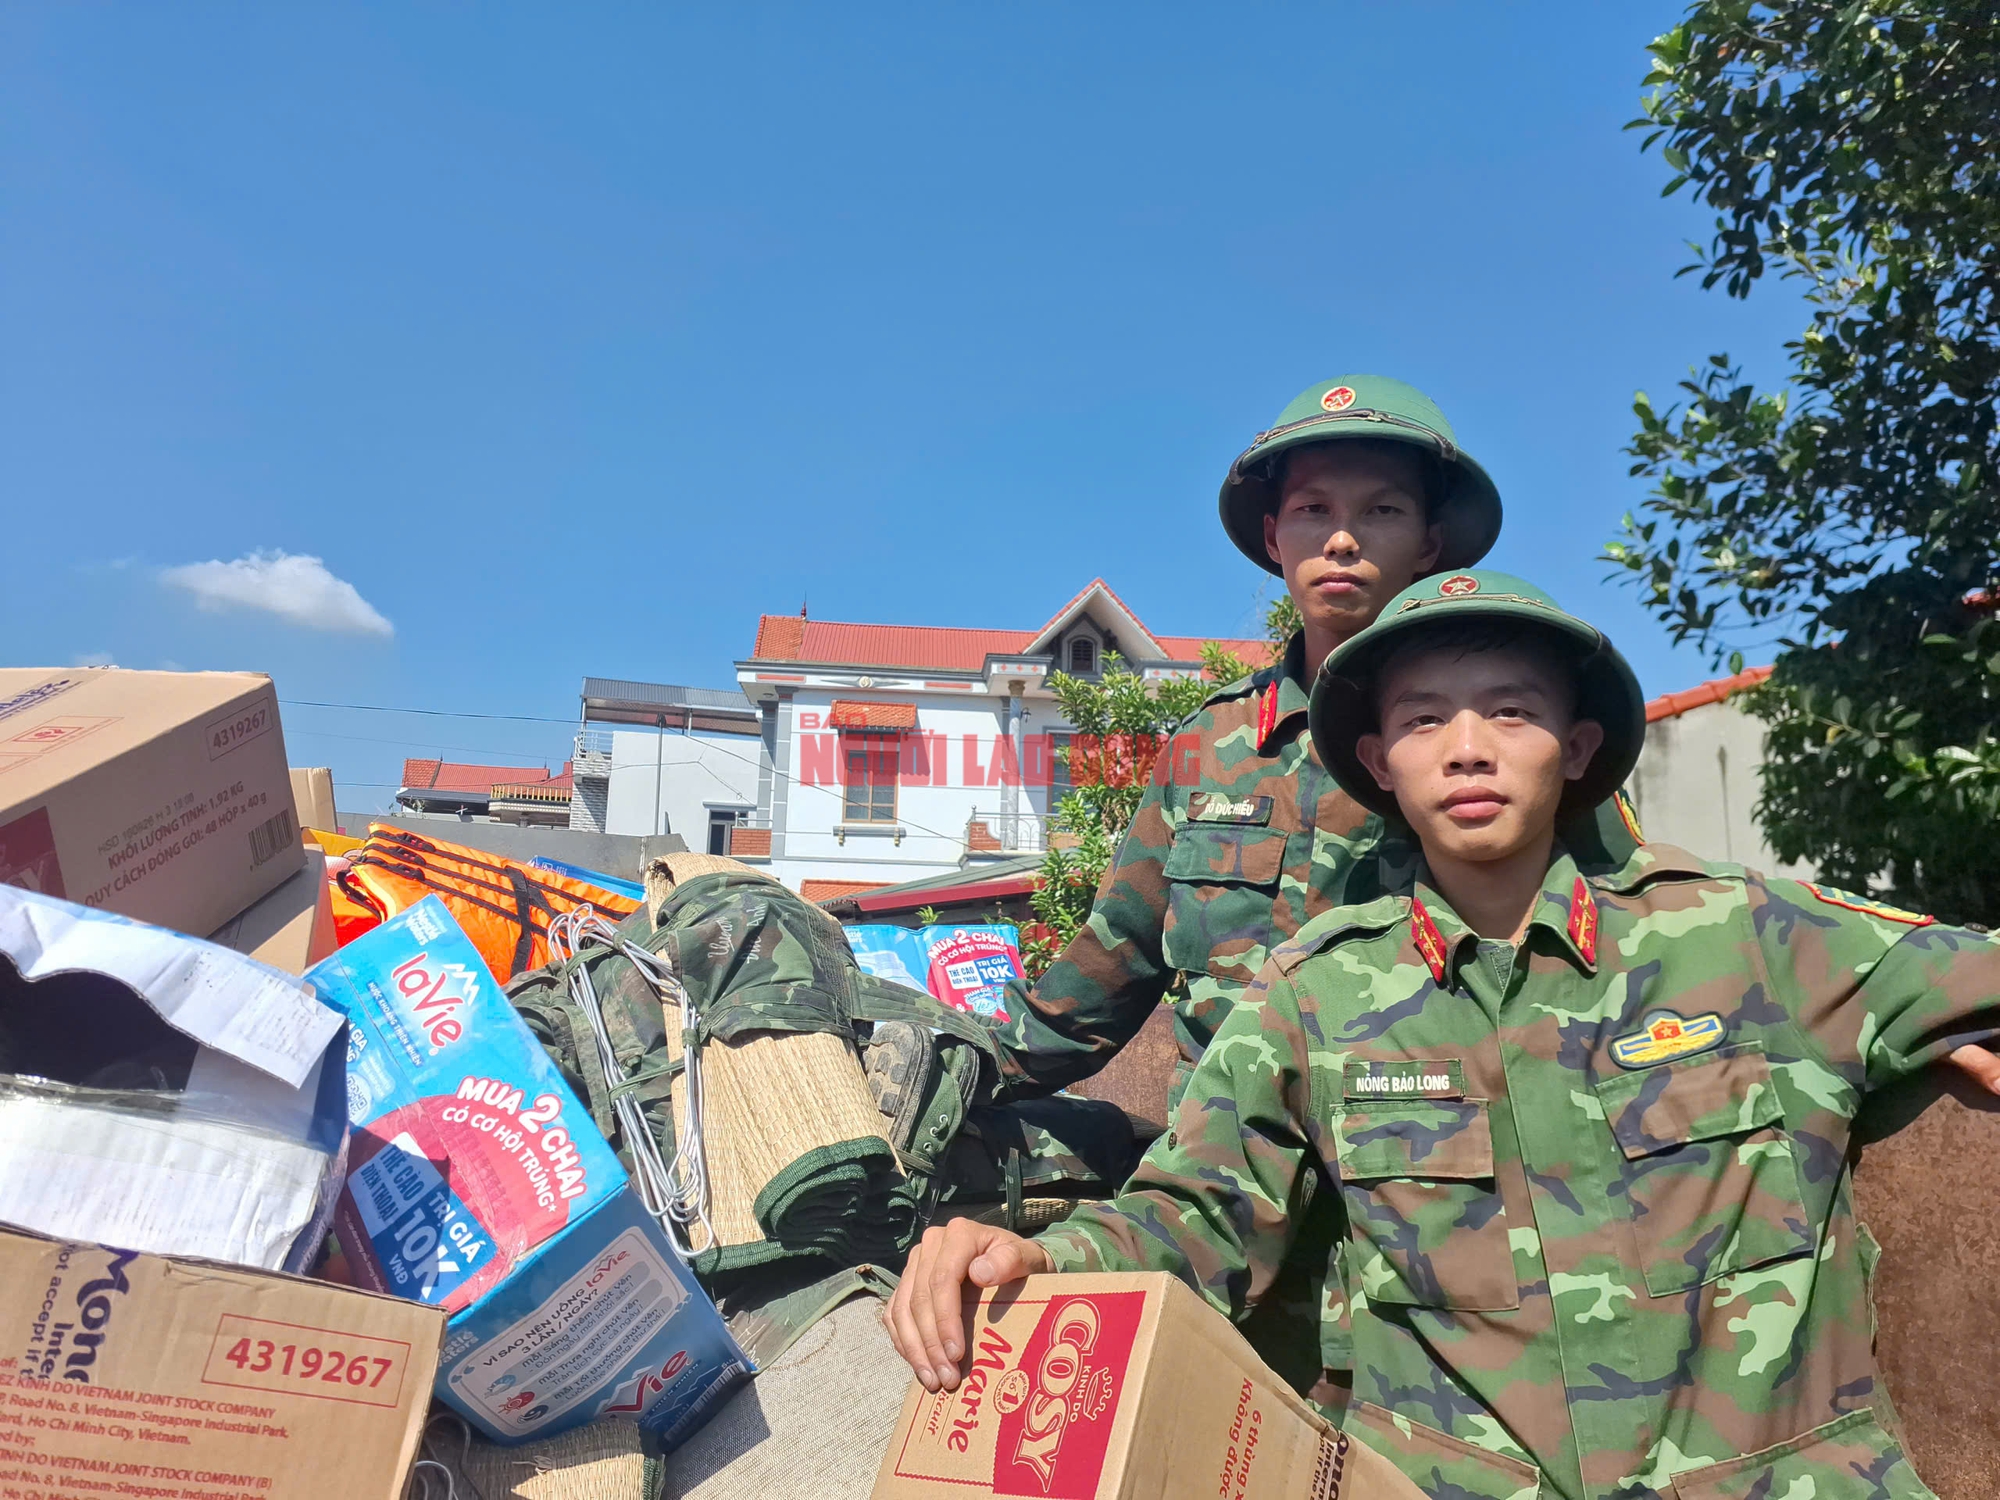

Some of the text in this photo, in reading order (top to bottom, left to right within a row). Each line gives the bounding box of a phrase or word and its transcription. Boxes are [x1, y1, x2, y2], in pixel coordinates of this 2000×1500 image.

[213, 709, 267, 748] 4319267
[108, 842, 139, 870] KHỐI
[140, 818, 180, 852] LƯỢNG
[230, 781, 244, 797] KG
[84, 885, 112, 907] QUY
[113, 863, 147, 892] CÁCH
[147, 842, 181, 873] ĐÓNG
[182, 829, 204, 850] GÓI:
[205, 820, 218, 835] 48
[218, 805, 239, 827] HỘP
[927, 929, 1005, 959] MUA 2 CHAI
[938, 954, 949, 966] CÓ
[947, 948, 960, 959] CƠ
[959, 944, 975, 954] HỘI
[991, 955, 1007, 965] GIÁ
[979, 965, 1014, 980] 10K
[368, 981, 423, 1067] NƯỚC KHOÁNG THIÊN NHIÊN
[1356, 1071, 1450, 1092] NÔNG BẢO LONG
[442, 1105, 470, 1123] CÓ
[470, 1113, 500, 1132] CƠ
[493, 1125, 525, 1154] HỘI
[457, 1077, 585, 1199] MUA 2 CHAI
[360, 1163, 378, 1190] ĐIỆN
[371, 1180, 399, 1222] THOẠI
[380, 1144, 425, 1202] THẺ CÀO
[429, 1191, 487, 1263] TRỊ GIÁ
[389, 1253, 409, 1285] VNĐ
[394, 1208, 461, 1299] 10K
[30, 1276, 62, 1343] accept
[521, 1288, 598, 1354] 3 LẦN NGÀY?
[543, 1334, 570, 1353] Sáng
[569, 1311, 593, 1333] thêm
[593, 1290, 614, 1311] chút
[614, 1274, 632, 1290] Yên
[558, 1354, 582, 1371] Trưa
[602, 1315, 621, 1335] chút
[621, 1298, 639, 1314] Yên
[439, 1335, 480, 1366] aters
[483, 1355, 498, 1367] VÌ
[499, 1339, 525, 1358] SAO
[526, 1319, 552, 1339] NÊN
[622, 1325, 642, 1345] chút
[226, 1337, 393, 1389] 4319267
[535, 1353, 556, 1369] Đón
[604, 1350, 688, 1413] Vie
[9, 1394, 44, 1408] Road
[46, 1399, 67, 1412] No.
[85, 1403, 202, 1428] Vietnam-Singapore
[204, 1418, 260, 1435] Industrial
[18, 1376, 51, 1391] KINH
[52, 1381, 73, 1395] DO
[76, 1384, 135, 1402] VIETNAM
[135, 1392, 174, 1407] JOINT
[174, 1397, 216, 1412] STOCK
[216, 1402, 276, 1419] COMPANY
[927, 1389, 950, 1436] iscuit
[947, 1326, 1013, 1453] Marie
[1012, 1297, 1101, 1493] COSY
[1069, 1365, 1092, 1423] KINH DO
[28, 1416, 46, 1427] Ho
[49, 1418, 70, 1431] Chi
[72, 1421, 105, 1436] Minh
[108, 1424, 135, 1441] City,
[138, 1428, 191, 1445] Vietnam.
[1219, 1377, 1254, 1499] Không được
[1237, 1410, 1262, 1488] 6 thùng
[20, 1471, 41, 1484] No.
[27, 1452, 48, 1465] DO
[50, 1455, 110, 1473] VIETNAM
[111, 1463, 150, 1477] JOINT
[151, 1466, 193, 1482] STOCK
[194, 1471, 255, 1487] COMPANY
[256, 1476, 272, 1490] (B)
[1312, 1470, 1321, 1493] the
